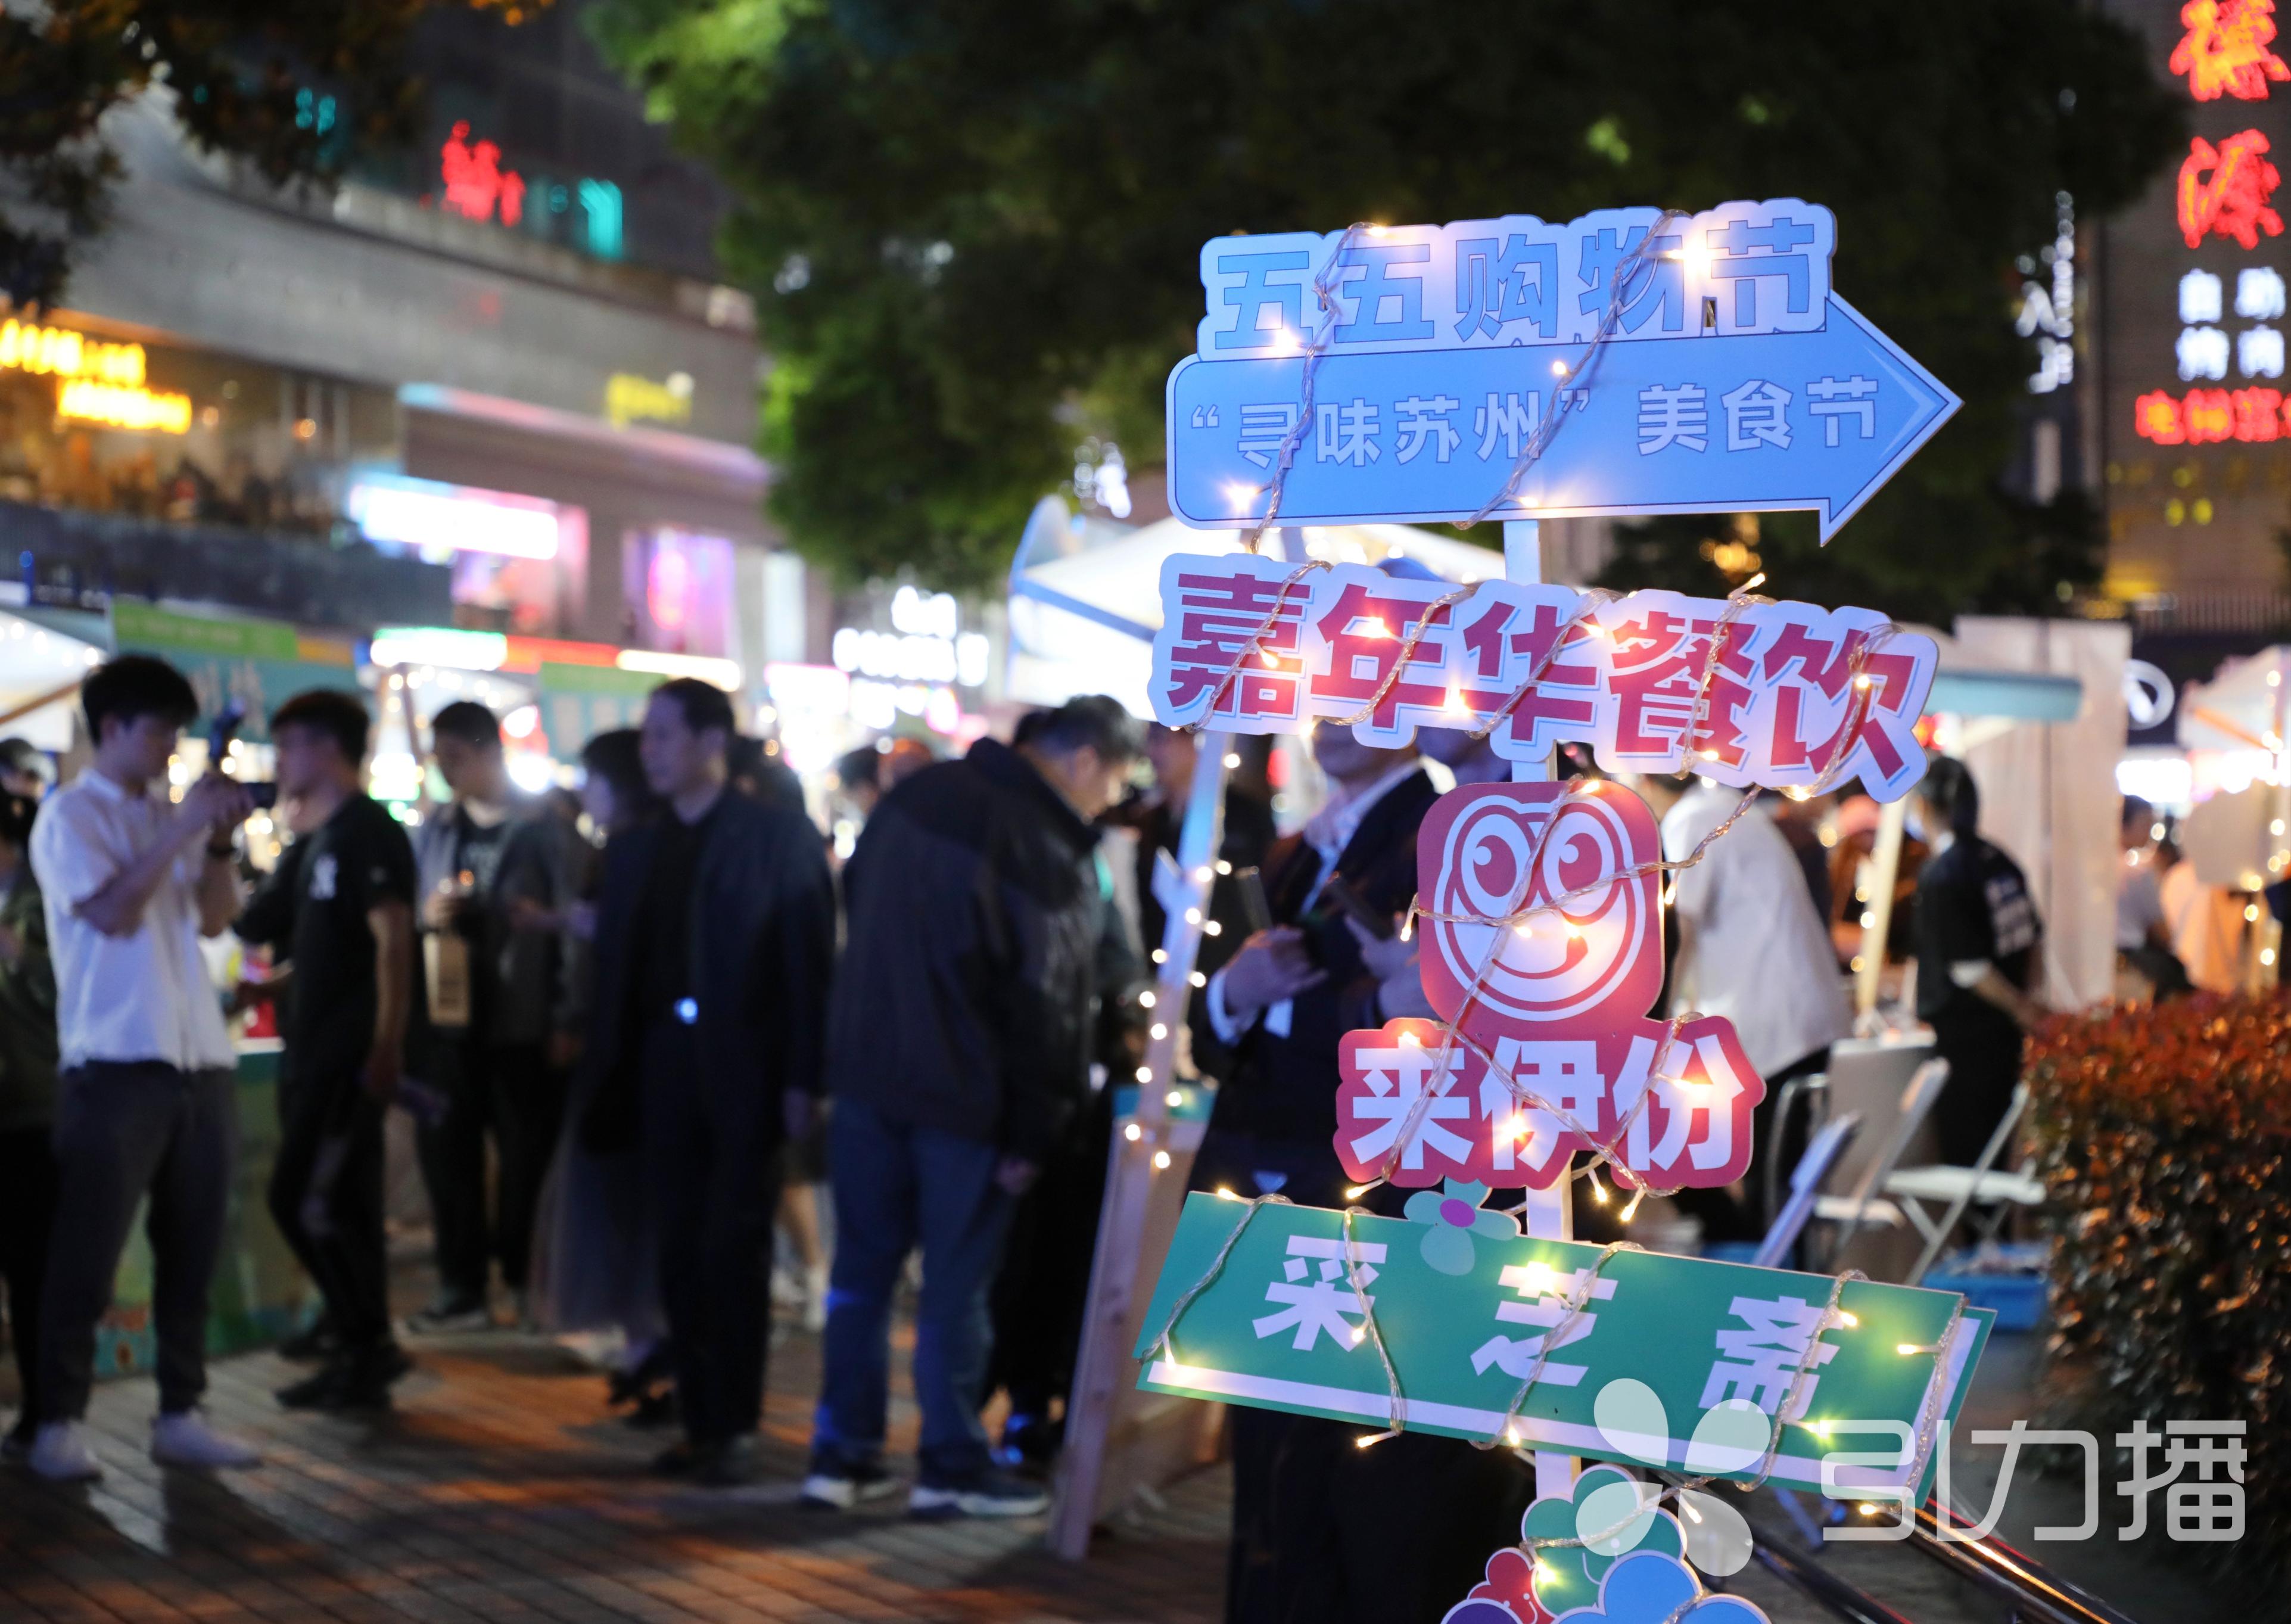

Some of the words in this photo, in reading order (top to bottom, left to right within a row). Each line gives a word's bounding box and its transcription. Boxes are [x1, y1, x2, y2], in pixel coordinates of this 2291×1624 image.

[1213, 216, 1816, 350] 五五购物节
[1636, 375, 1879, 456] 美食节
[1166, 572, 1916, 781] 嘉年华餐饮
[1349, 1034, 1746, 1172] 来伊份
[1252, 1234, 1845, 1418] 采芝斋
